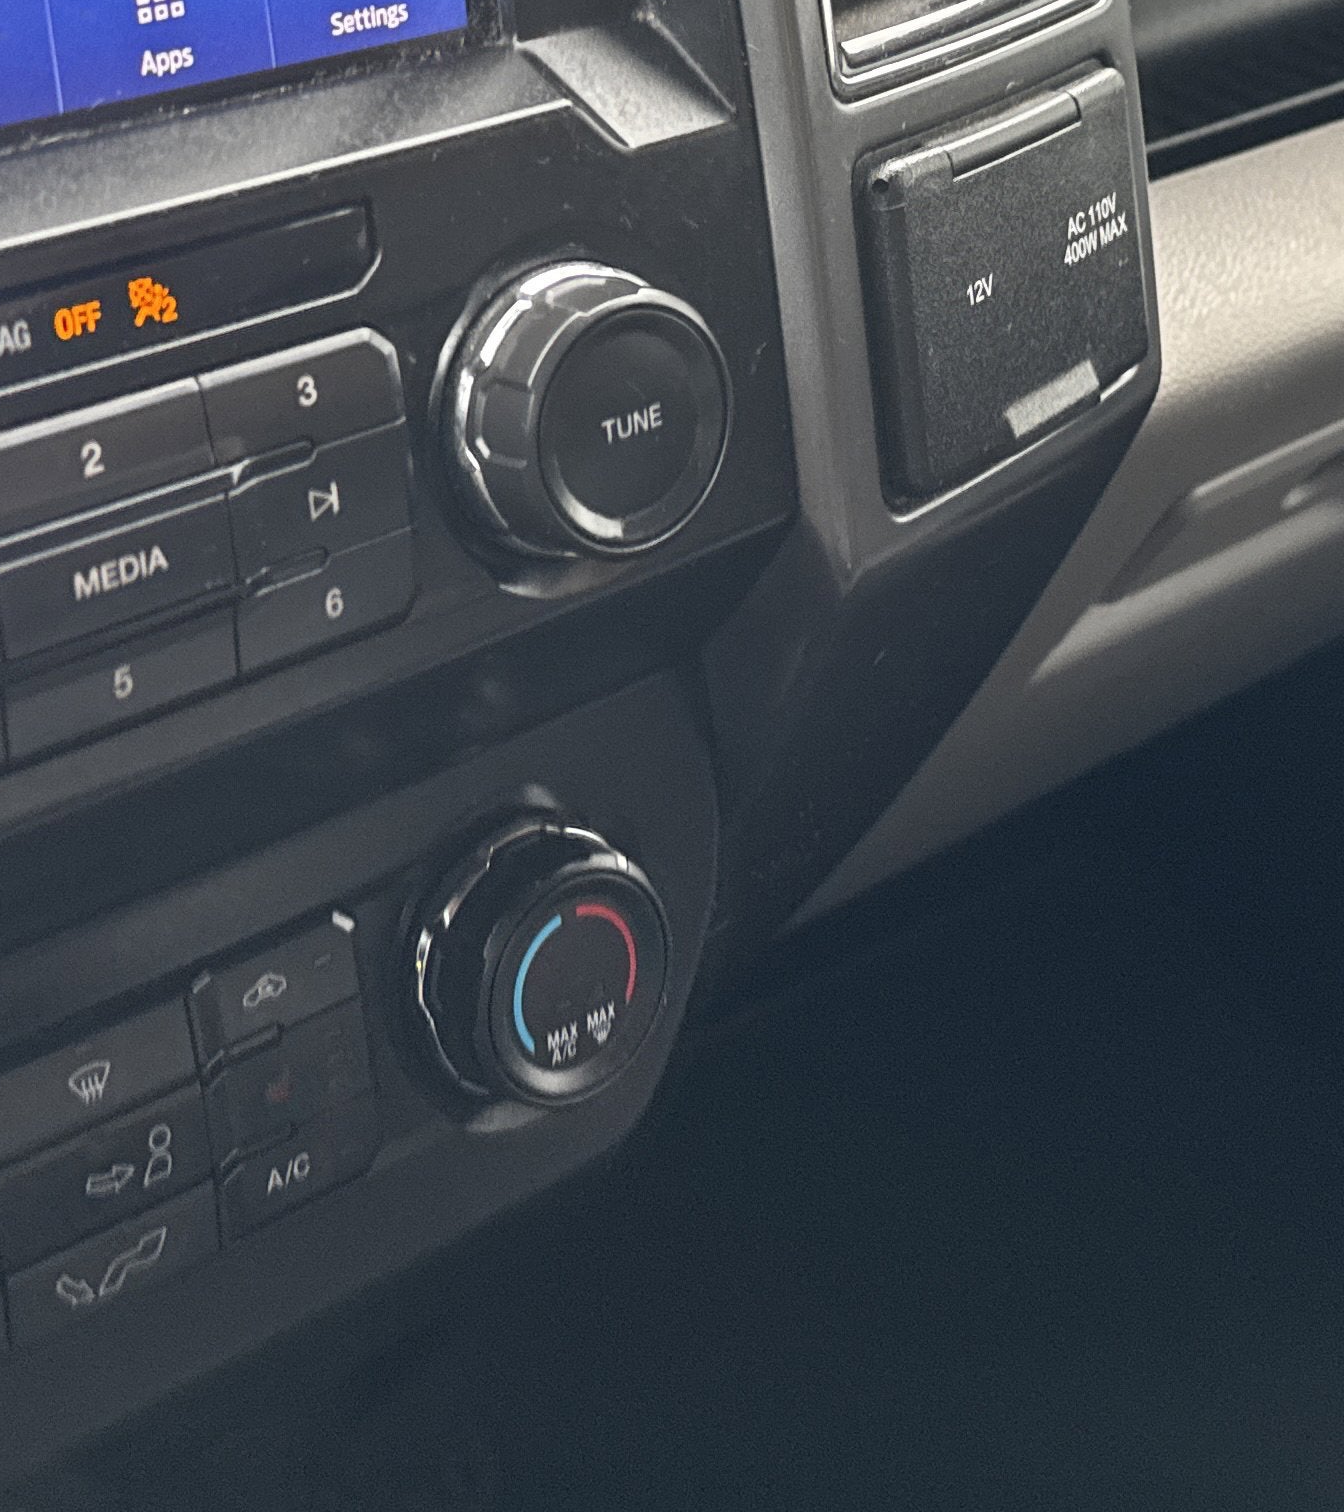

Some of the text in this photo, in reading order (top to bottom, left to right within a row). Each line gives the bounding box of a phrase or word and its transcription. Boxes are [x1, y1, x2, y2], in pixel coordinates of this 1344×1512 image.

[330, 2, 409, 37] Settings
[140, 46, 194, 78] Apps
[1067, 191, 1117, 239] AC 110V
[1063, 210, 1129, 266] 400W MAX
[966, 272, 994, 306] 12V
[54, 299, 103, 341] OFF
[296, 374, 318, 407] 3
[601, 401, 663, 445] TUNE
[81, 440, 105, 478] 2
[73, 544, 169, 600] MEDIA
[324, 588, 345, 618] 6
[113, 664, 134, 699] 5
[587, 1000, 615, 1034] MAX
[547, 1022, 578, 1052] MAX
[267, 1152, 310, 1195] A/C
